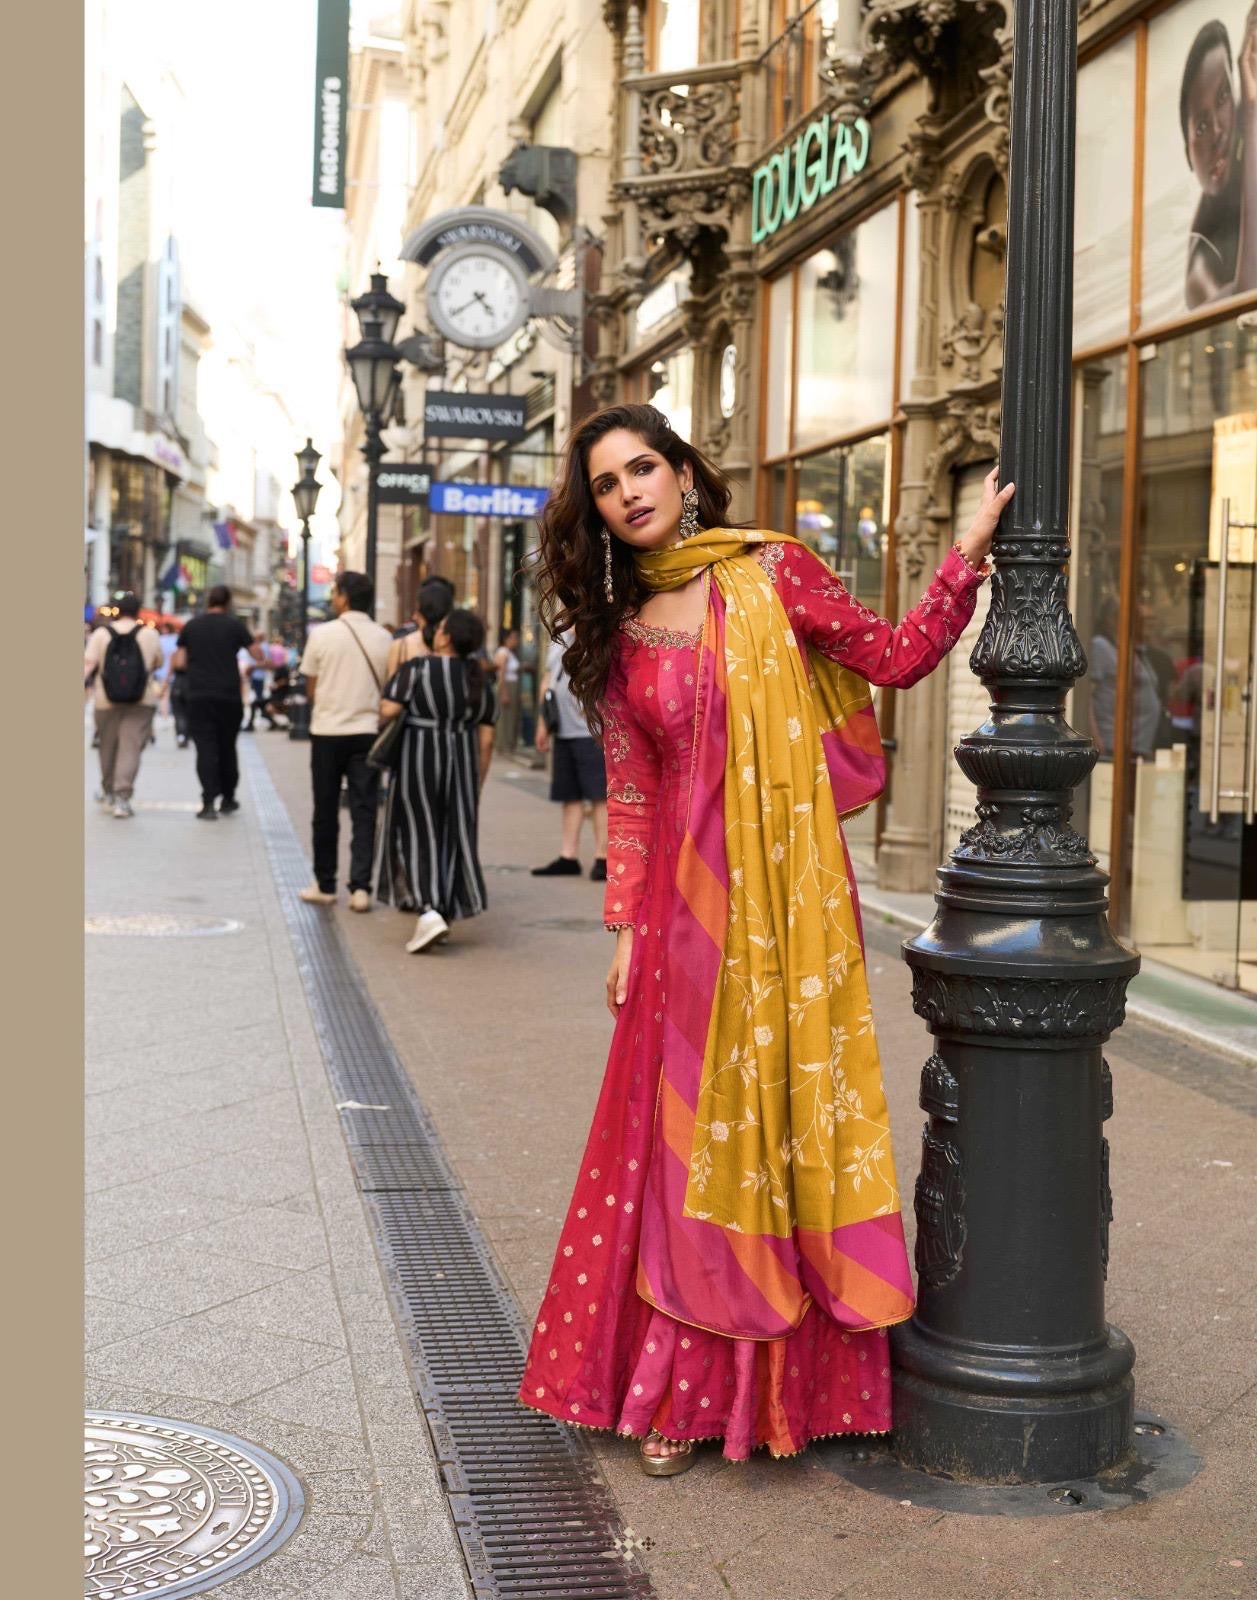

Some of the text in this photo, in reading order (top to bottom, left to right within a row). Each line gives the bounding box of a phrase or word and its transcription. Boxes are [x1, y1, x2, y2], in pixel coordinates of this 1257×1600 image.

[320, 76, 341, 194] McDonald's
[437, 224, 523, 252] SWAROVSKI
[425, 404, 524, 427] SWAROVSKI
[376, 472, 431, 488] OFFICE
[443, 486, 537, 515] Berlitz
